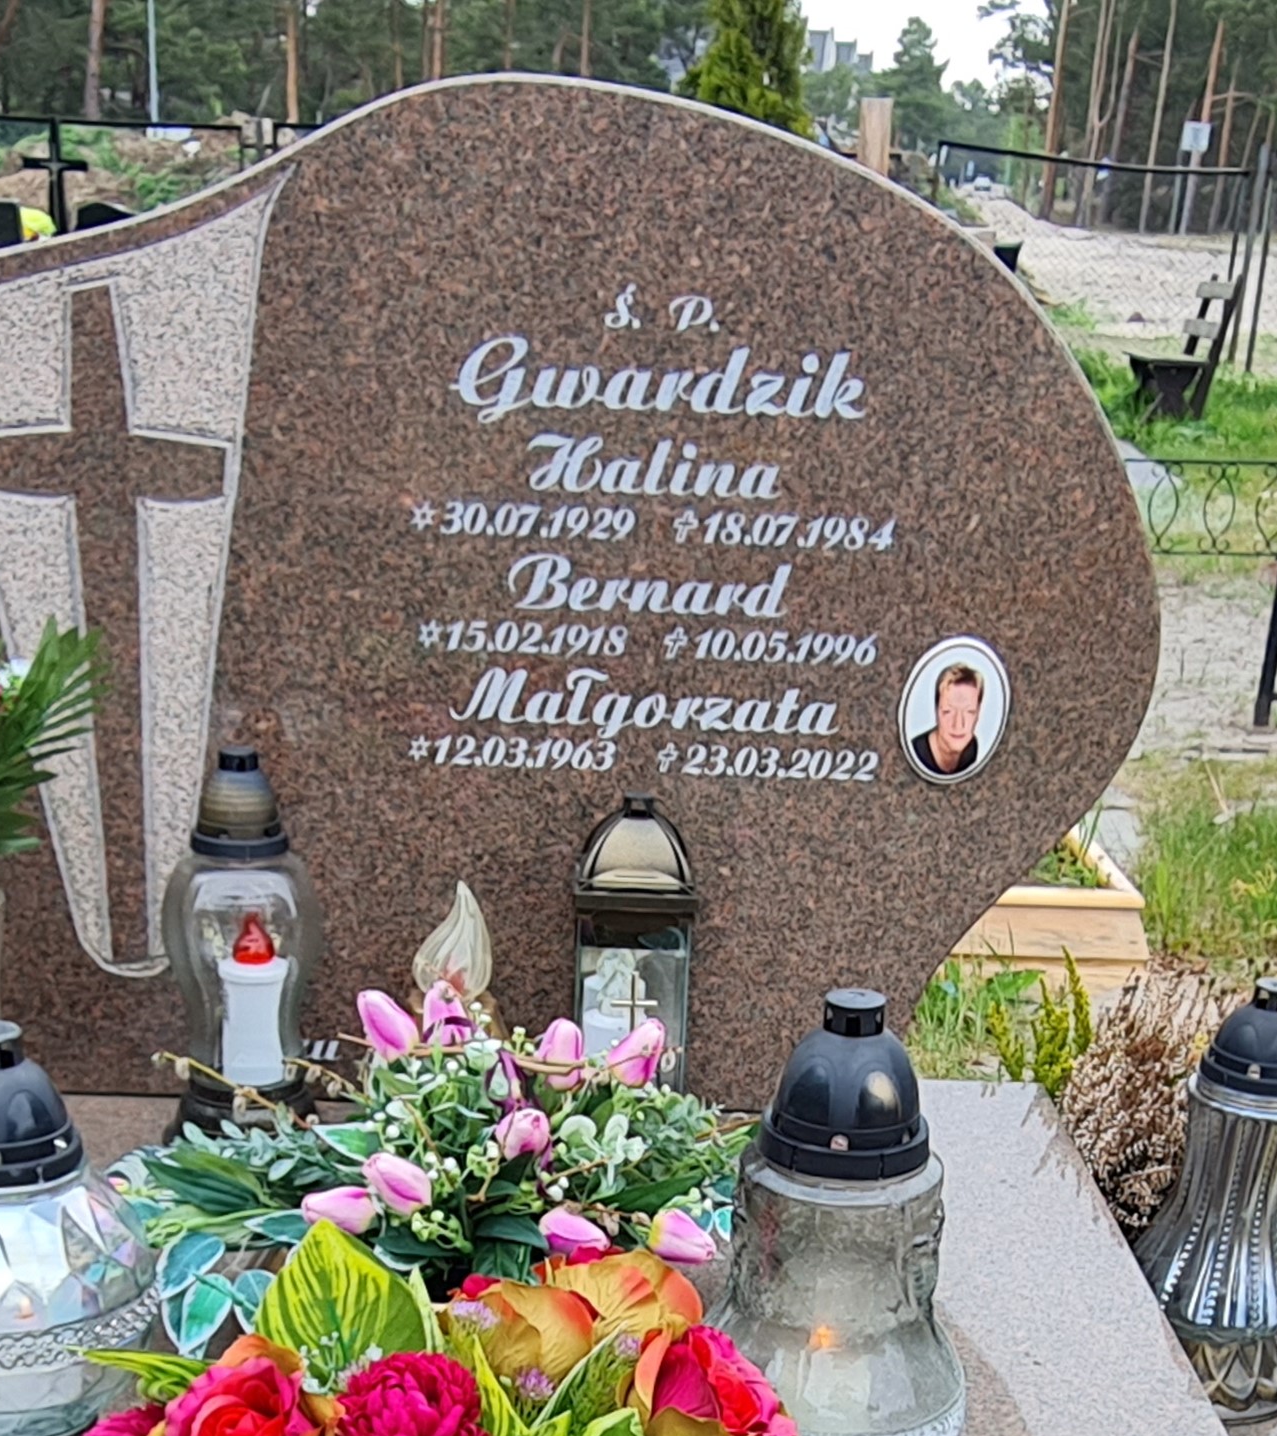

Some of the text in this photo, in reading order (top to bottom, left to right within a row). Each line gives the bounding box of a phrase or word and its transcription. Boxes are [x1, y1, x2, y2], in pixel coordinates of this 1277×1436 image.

[449, 336, 866, 424] Gwardzik
[526, 433, 781, 499] Halina
[439, 504, 896, 551] 30.07.1929 18.07.1984
[508, 552, 792, 618] Bernard
[443, 621, 879, 668] 15.02.1918 10.05.1996
[432, 735, 880, 783] 12.03.1963 23.03.2022
